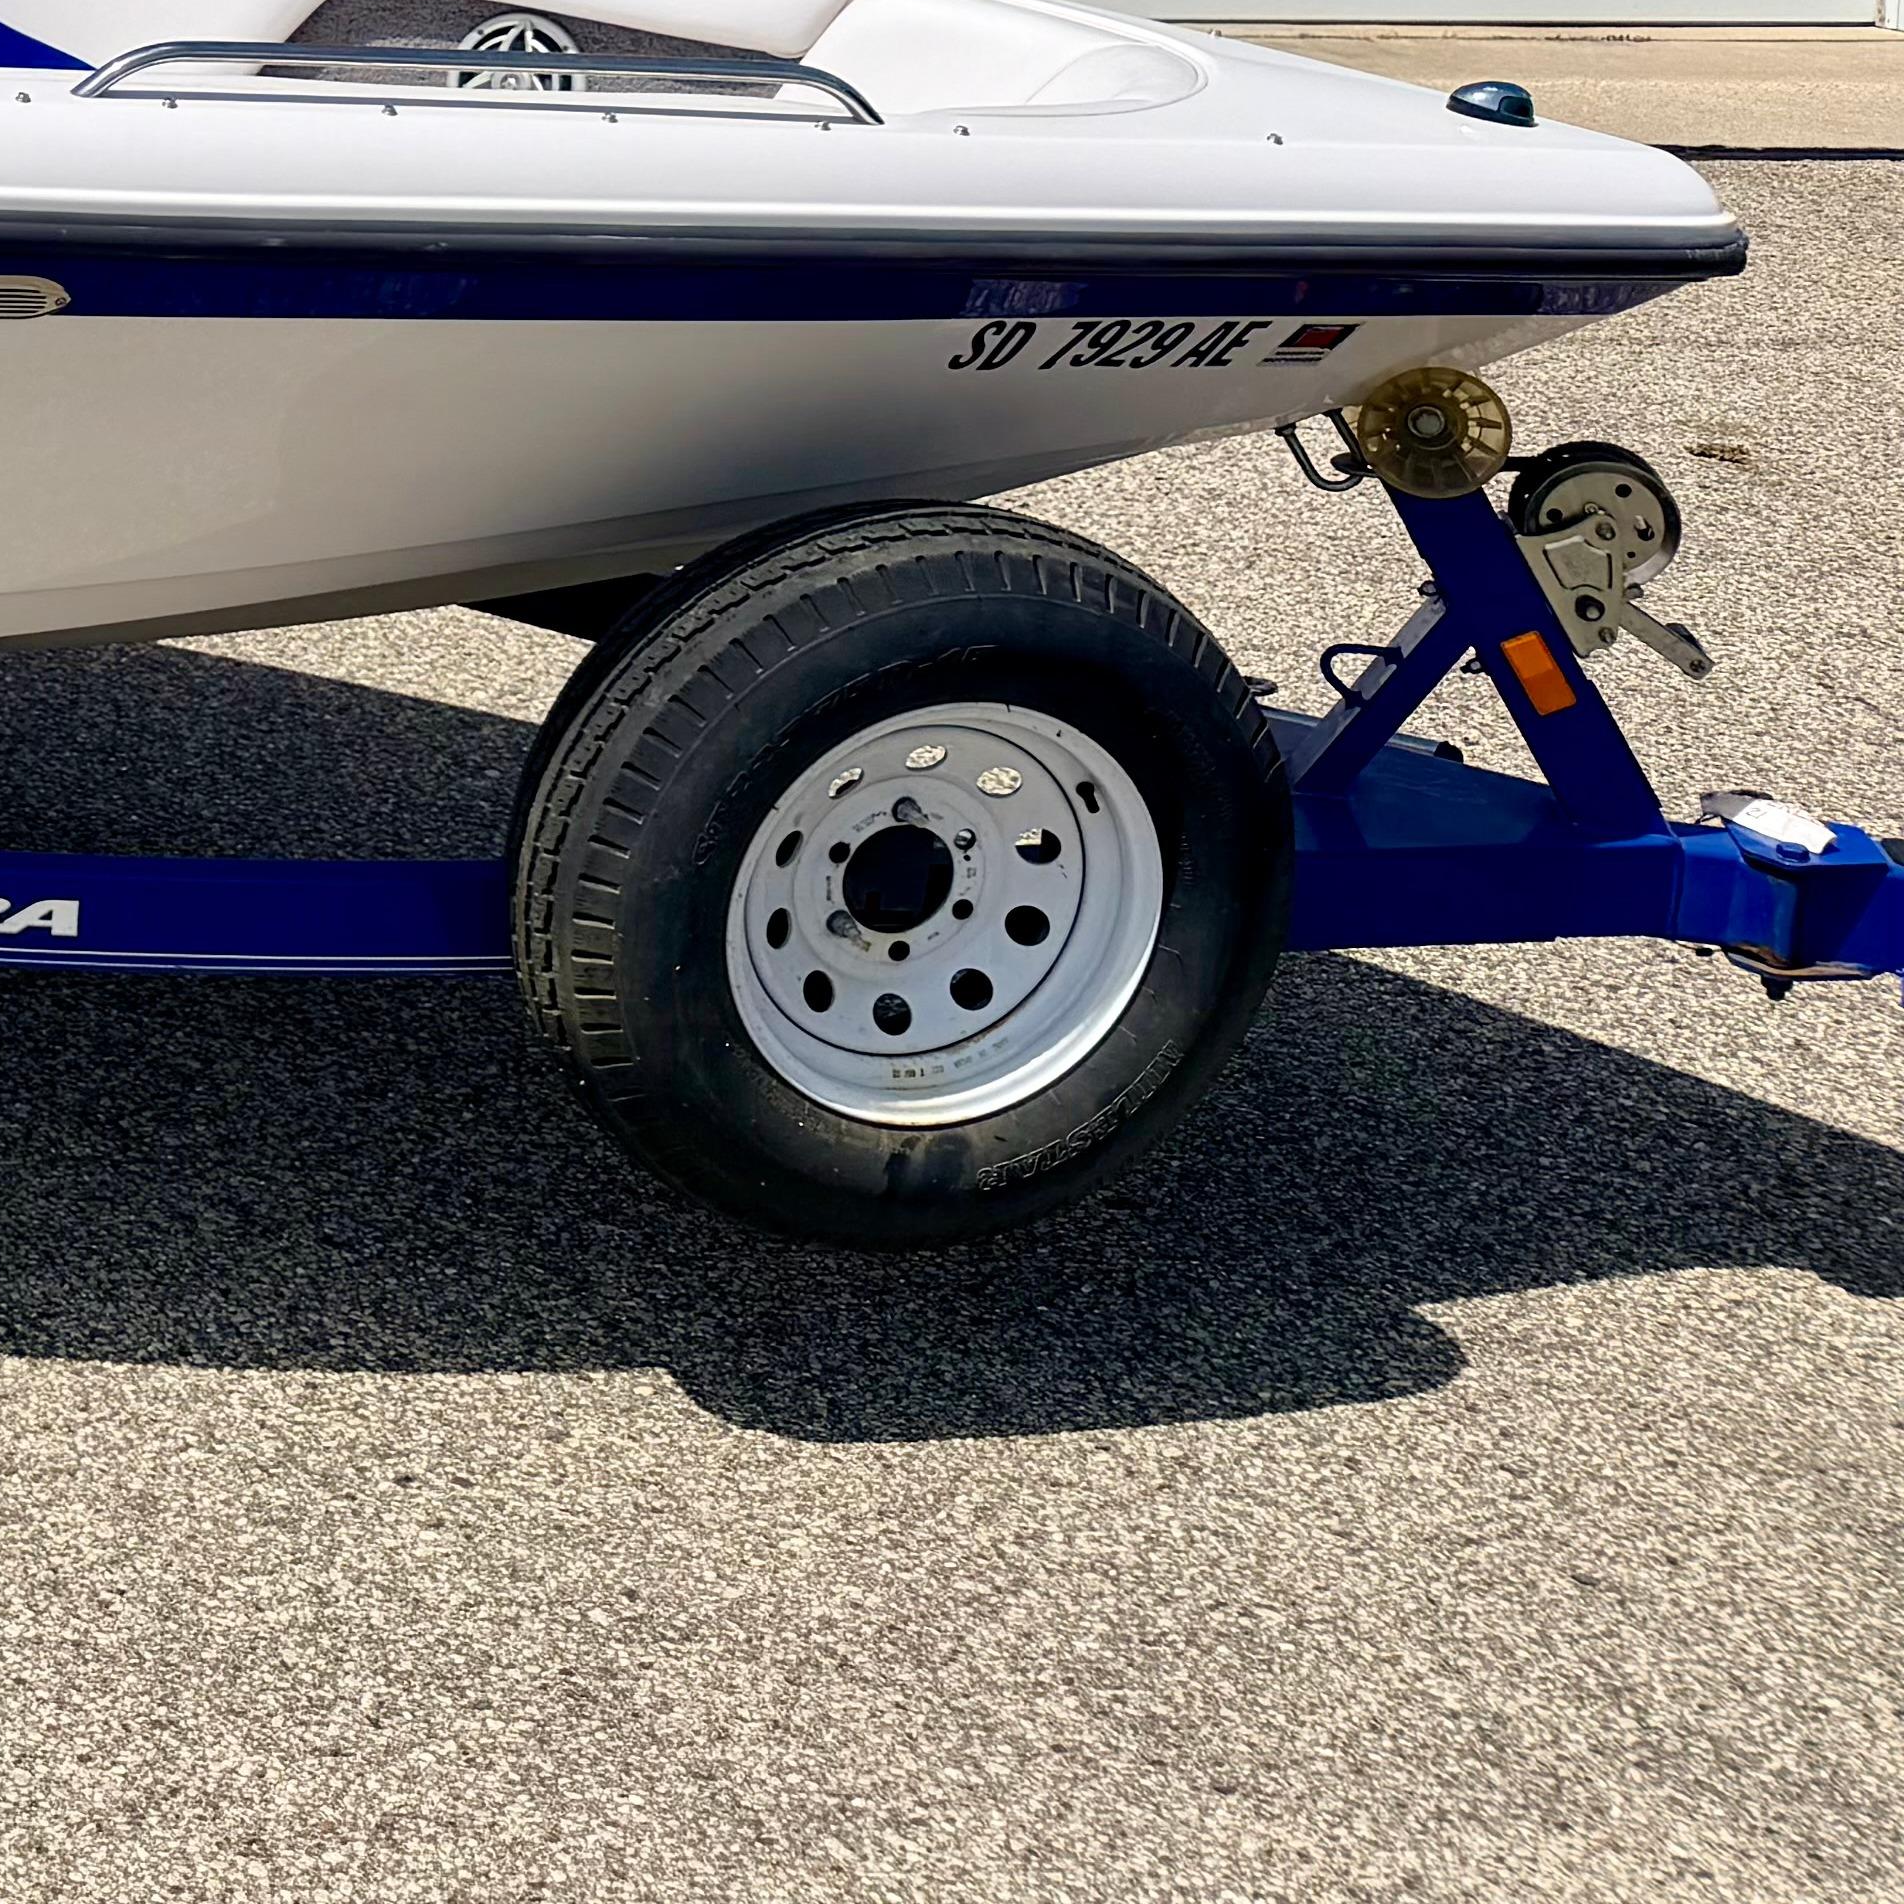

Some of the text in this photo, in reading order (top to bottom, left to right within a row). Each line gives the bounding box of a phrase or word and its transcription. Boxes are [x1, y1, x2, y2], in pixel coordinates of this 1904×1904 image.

[948, 319, 1273, 371] SD 7929 AE
